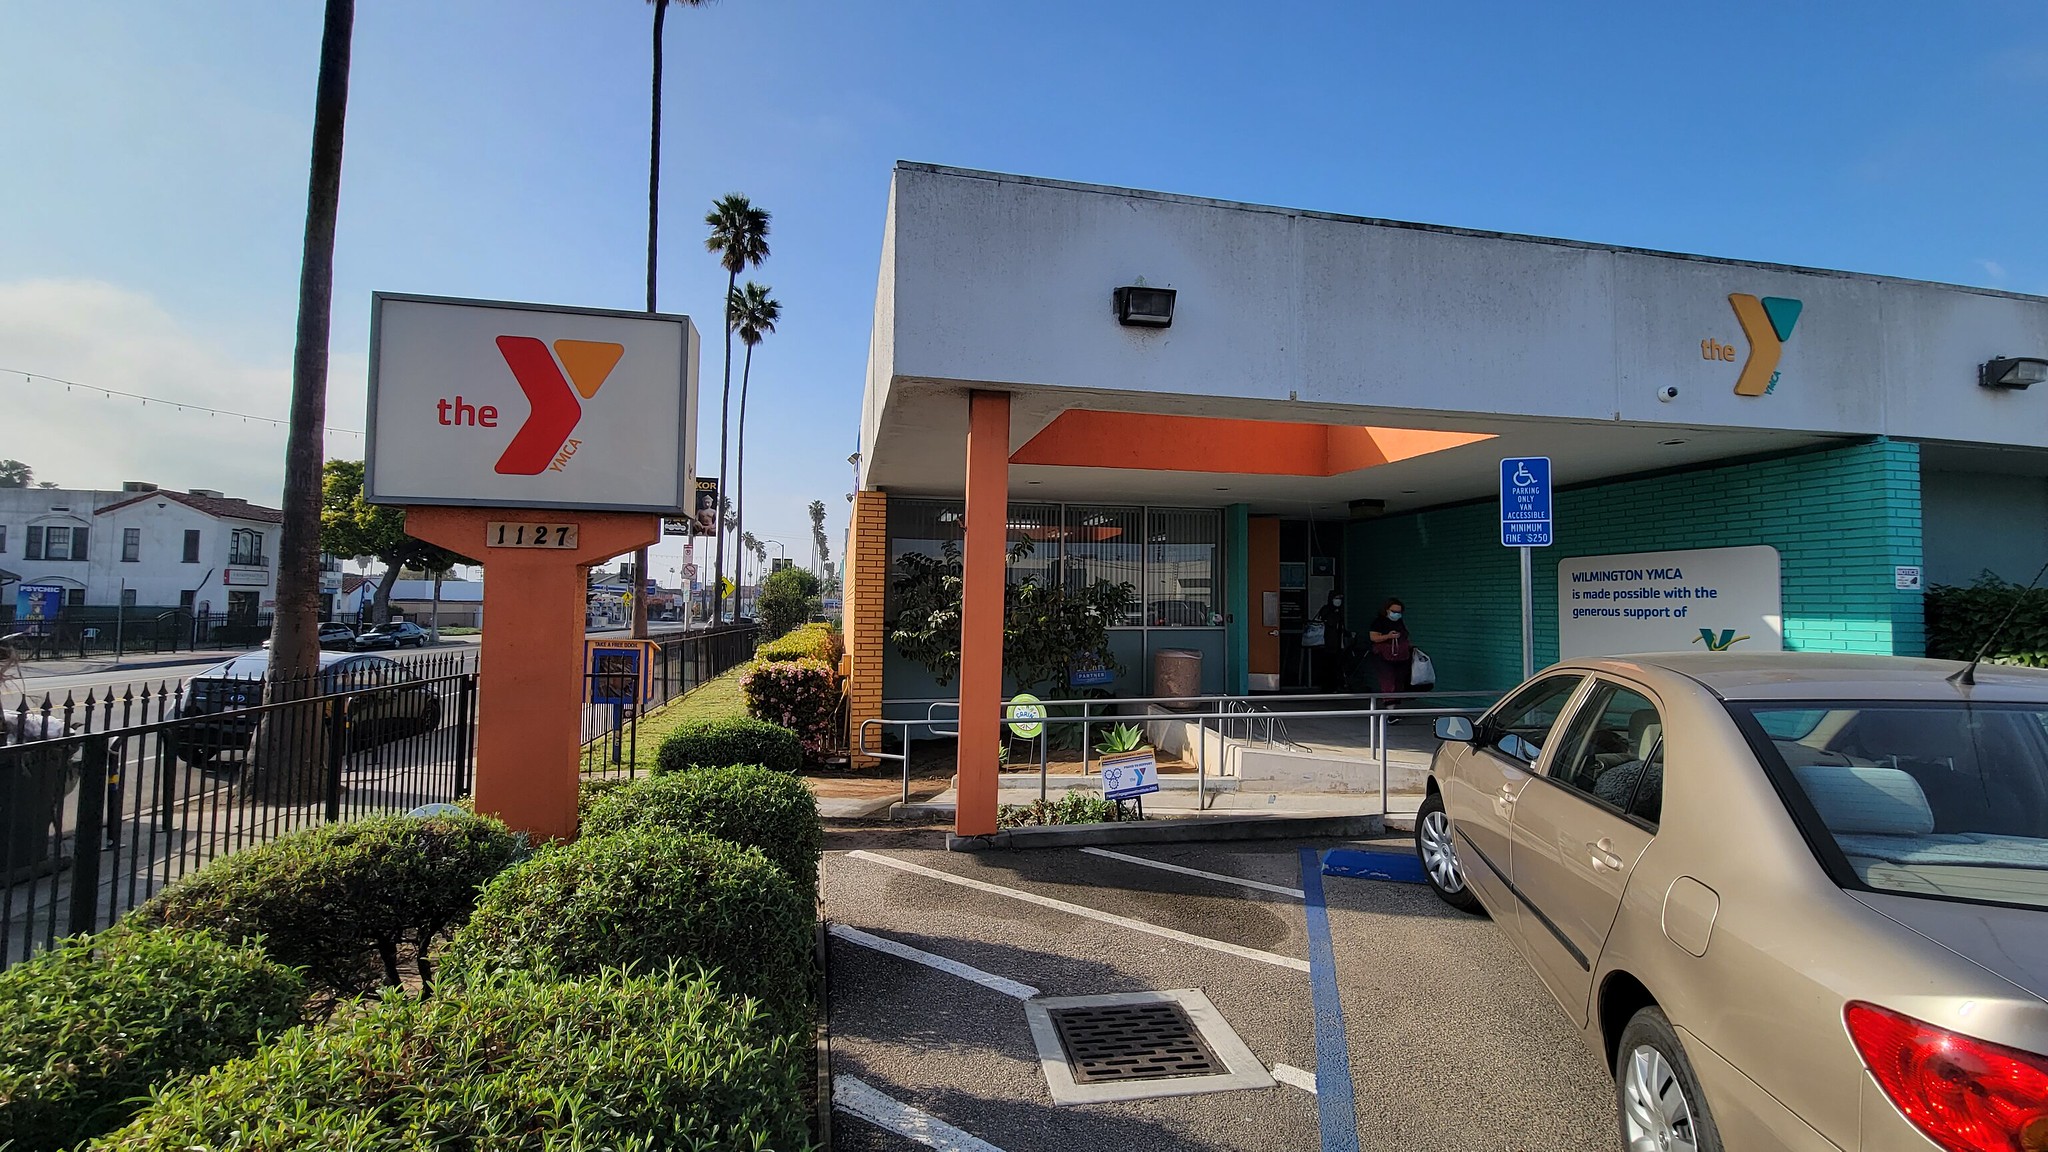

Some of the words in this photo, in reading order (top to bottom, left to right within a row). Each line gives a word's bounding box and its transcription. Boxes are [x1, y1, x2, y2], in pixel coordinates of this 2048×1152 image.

[1701, 338, 1736, 362] the
[1764, 371, 1781, 395] YMCA
[437, 396, 498, 427] the
[549, 438, 582, 472] YMCA
[1512, 486, 1540, 495] PARKING
[1517, 495, 1535, 503] ONLY
[1519, 503, 1533, 511] VAN
[1507, 511, 1545, 519] ACCESSIBLE
[1510, 523, 1542, 532] MINIMUM
[497, 525, 569, 547] 1127
[1505, 533, 1521, 543] FINE
[1526, 533, 1548, 542] $250
[1571, 569, 1643, 582] WILMINGTON
[1646, 568, 1683, 580] YMCA
[1572, 589, 1580, 600] is
[1583, 588, 1611, 599] made
[1613, 587, 1660, 602] possible
[1663, 587, 1691, 599] with
[1694, 587, 1718, 598] the
[1572, 607, 1621, 618] generous
[1623, 607, 1670, 619] support
[1673, 606, 1688, 618] of
